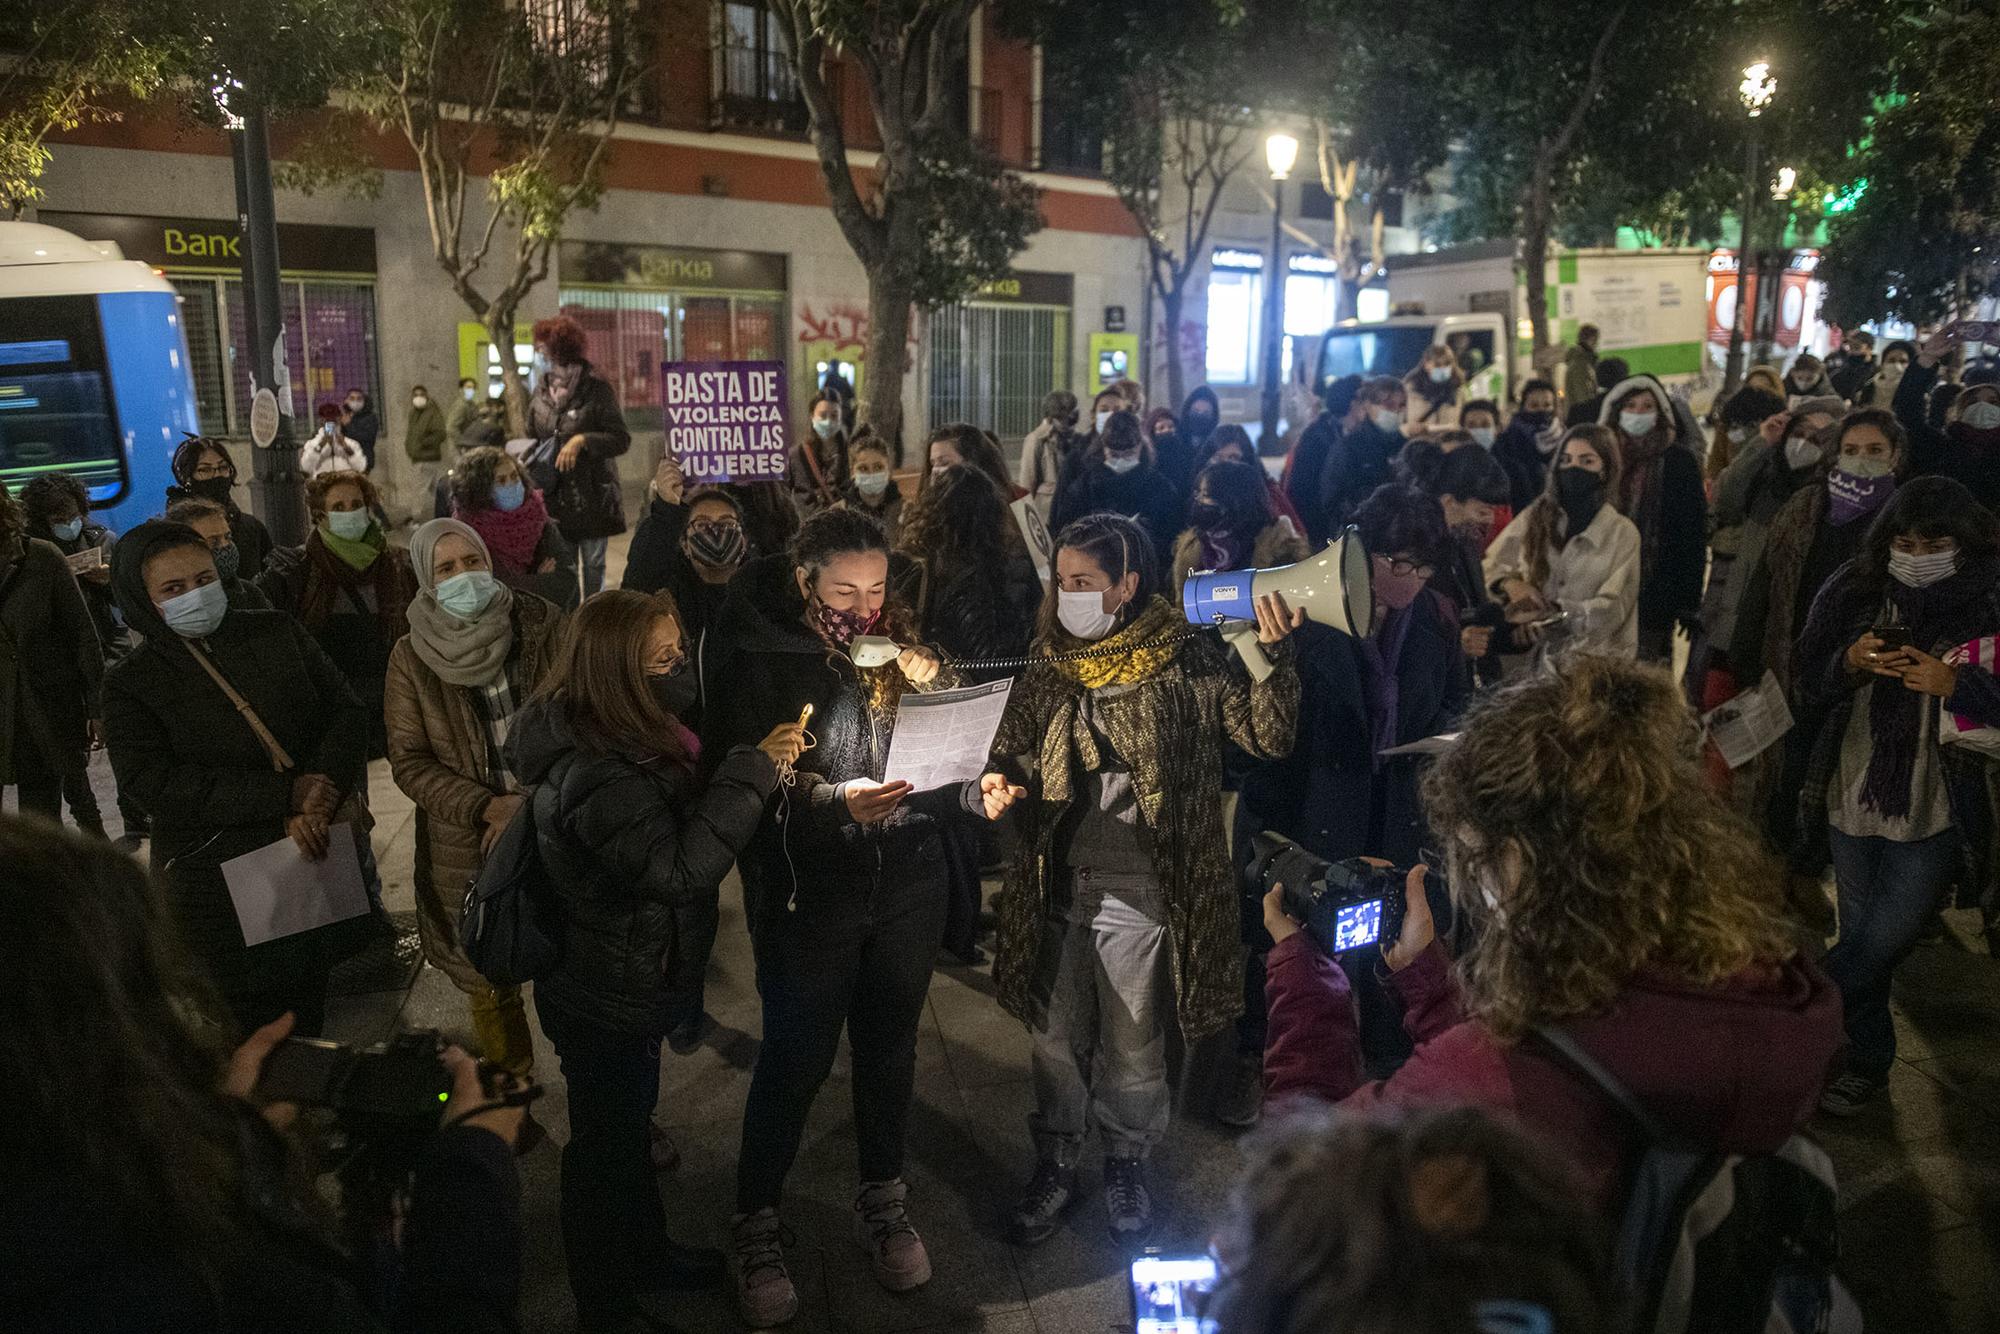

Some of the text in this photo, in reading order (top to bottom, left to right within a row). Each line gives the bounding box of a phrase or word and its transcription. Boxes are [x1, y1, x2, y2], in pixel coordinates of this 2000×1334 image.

[667, 371, 778, 404] BASTA DE
[668, 405, 782, 424] VIOLENCIA
[670, 425, 784, 453] CONTRA LAS
[672, 453, 785, 477] MUJERES
